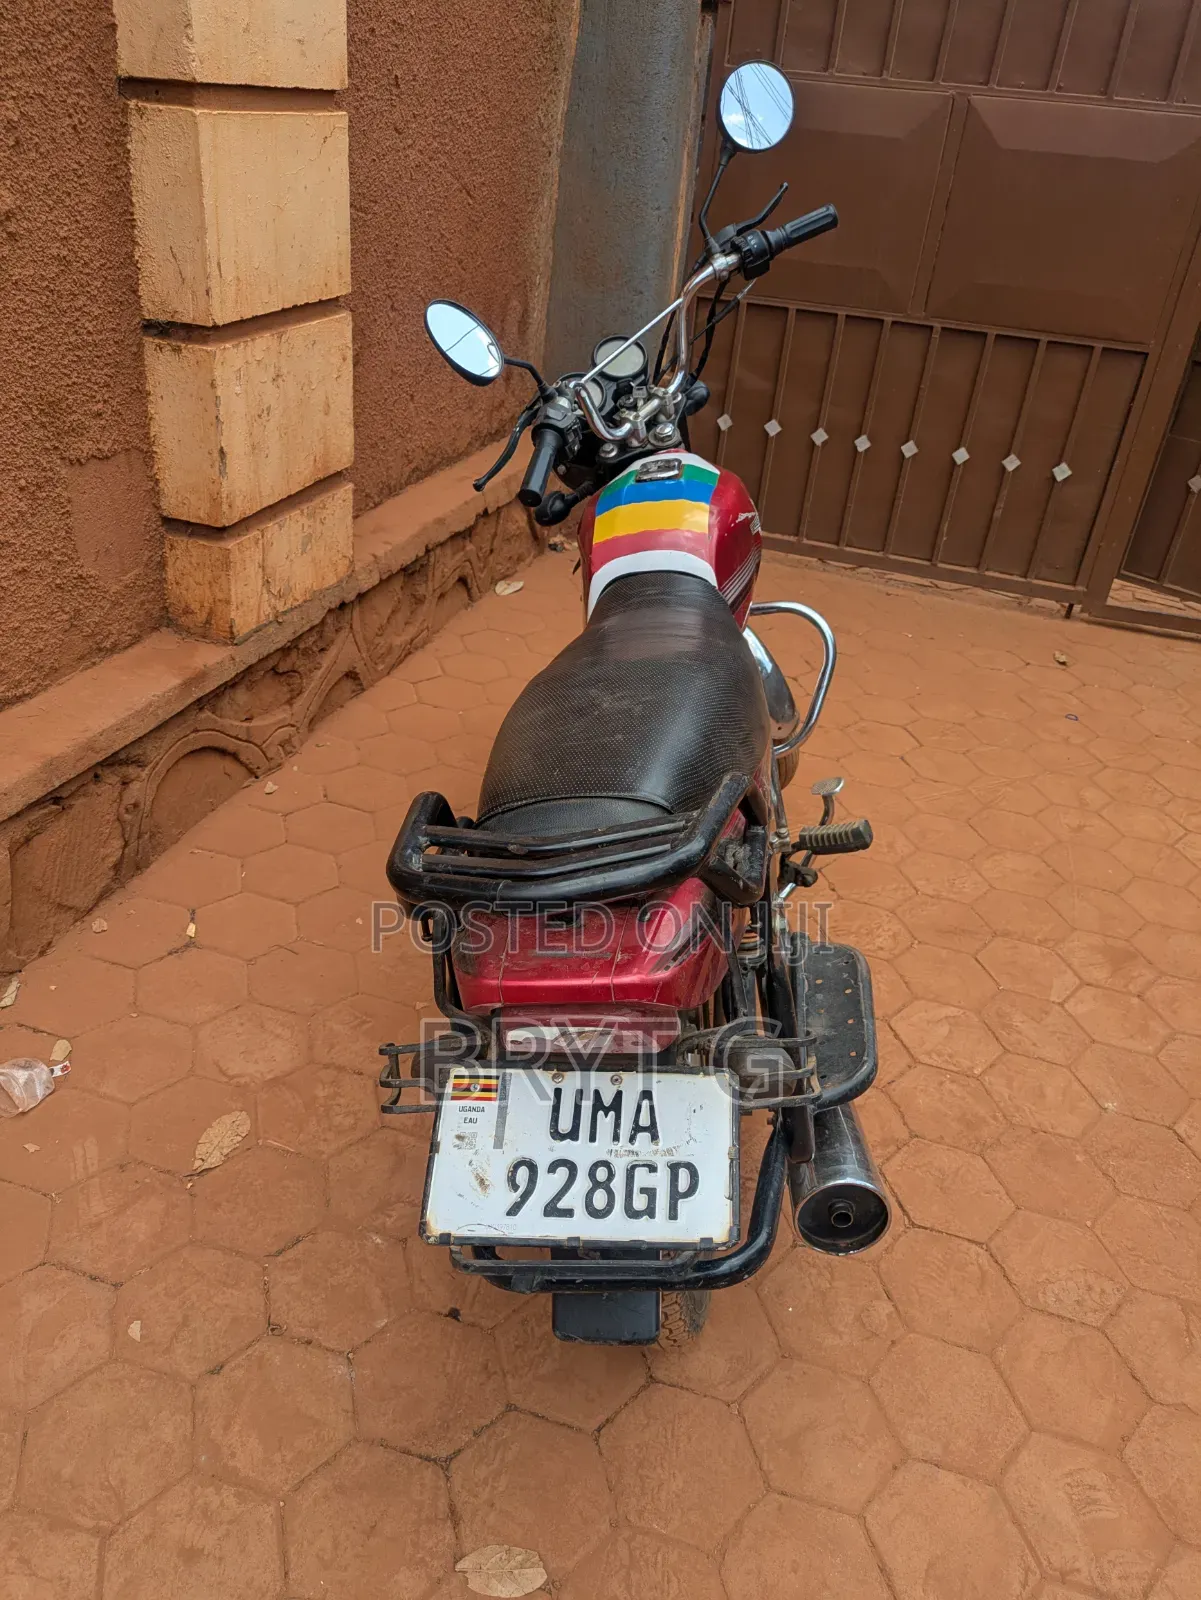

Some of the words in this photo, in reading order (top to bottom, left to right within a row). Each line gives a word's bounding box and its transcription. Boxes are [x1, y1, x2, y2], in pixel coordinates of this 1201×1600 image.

[458, 1105, 486, 1113] UGANDA
[550, 1087, 660, 1146] UMA
[506, 1157, 700, 1221] 928GP
